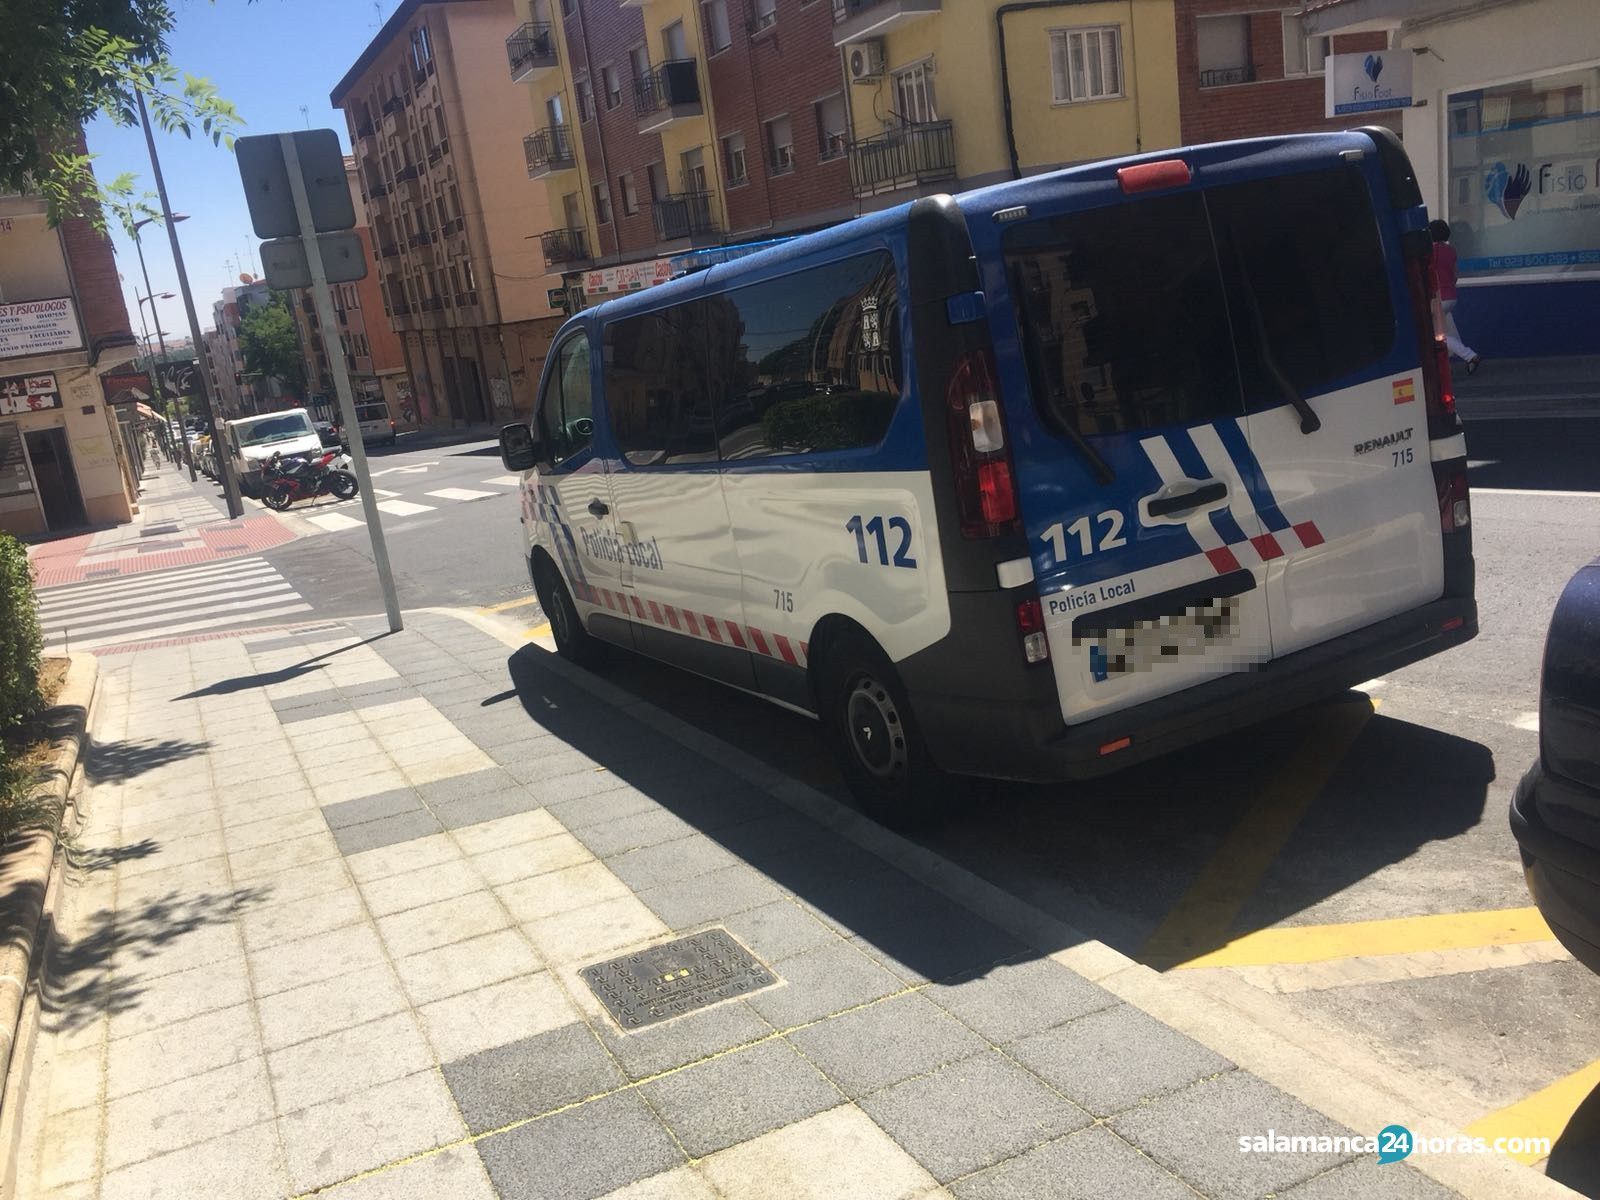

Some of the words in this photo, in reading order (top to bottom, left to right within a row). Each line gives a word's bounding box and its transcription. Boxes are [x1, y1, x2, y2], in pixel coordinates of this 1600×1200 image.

[1539, 163, 1588, 194] Fisio
[9, 306, 15, 316] Y
[16, 300, 67, 316] PSICOLOGOS
[1353, 427, 1414, 456] RENAULT
[1392, 447, 1414, 468] 715
[845, 515, 918, 569] 112
[1040, 509, 1127, 563] 112
[773, 589, 794, 613] 715
[1049, 589, 1097, 615] Policía
[1100, 578, 1136, 601] Local
